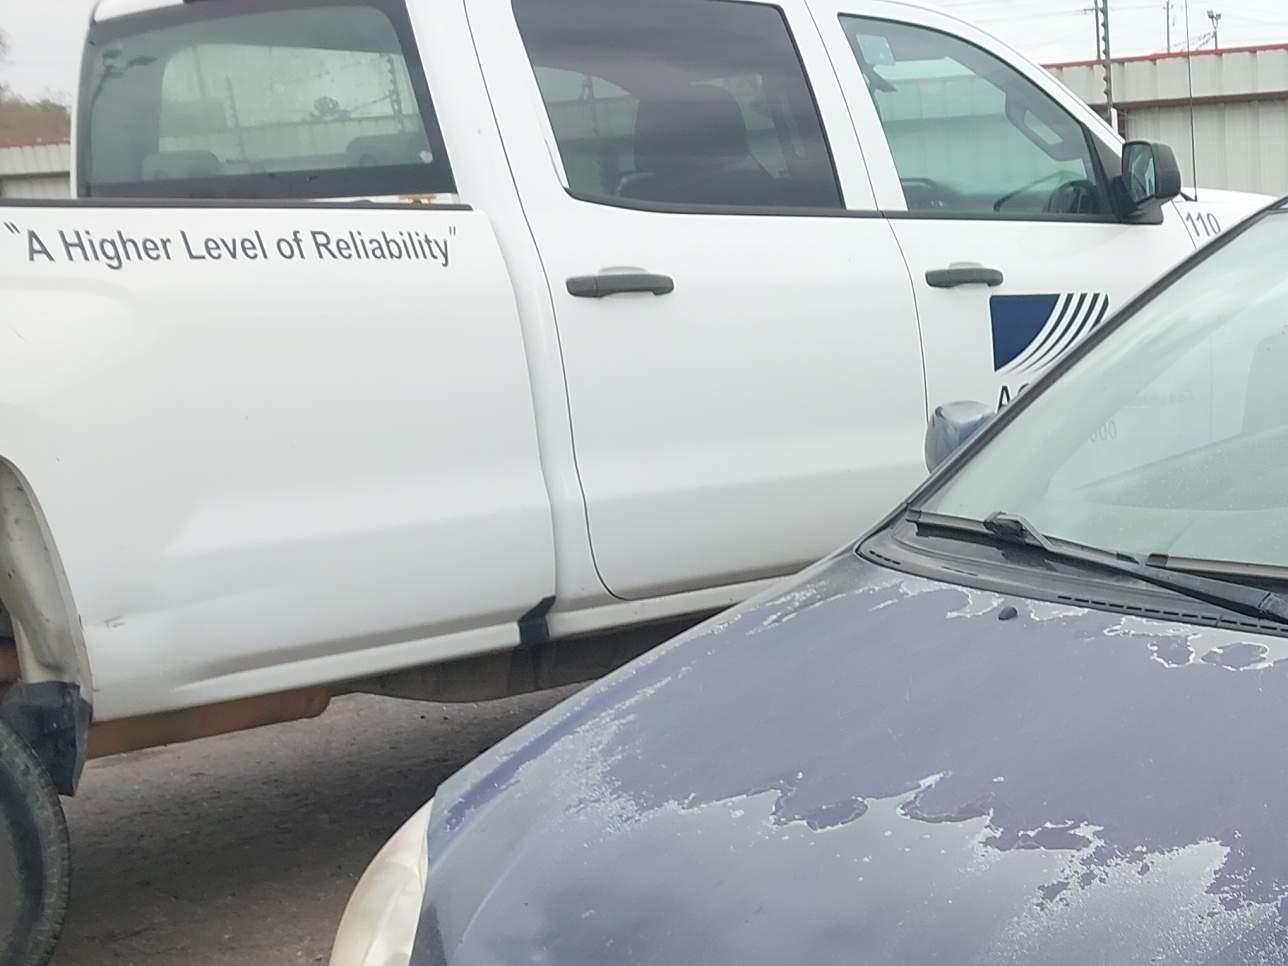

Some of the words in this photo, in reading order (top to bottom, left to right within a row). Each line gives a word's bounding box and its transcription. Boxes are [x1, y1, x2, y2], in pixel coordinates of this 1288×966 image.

[1185, 212, 1221, 237] 110
[57, 229, 172, 270] Higher
[179, 229, 268, 260] Level
[276, 230, 305, 260] of
